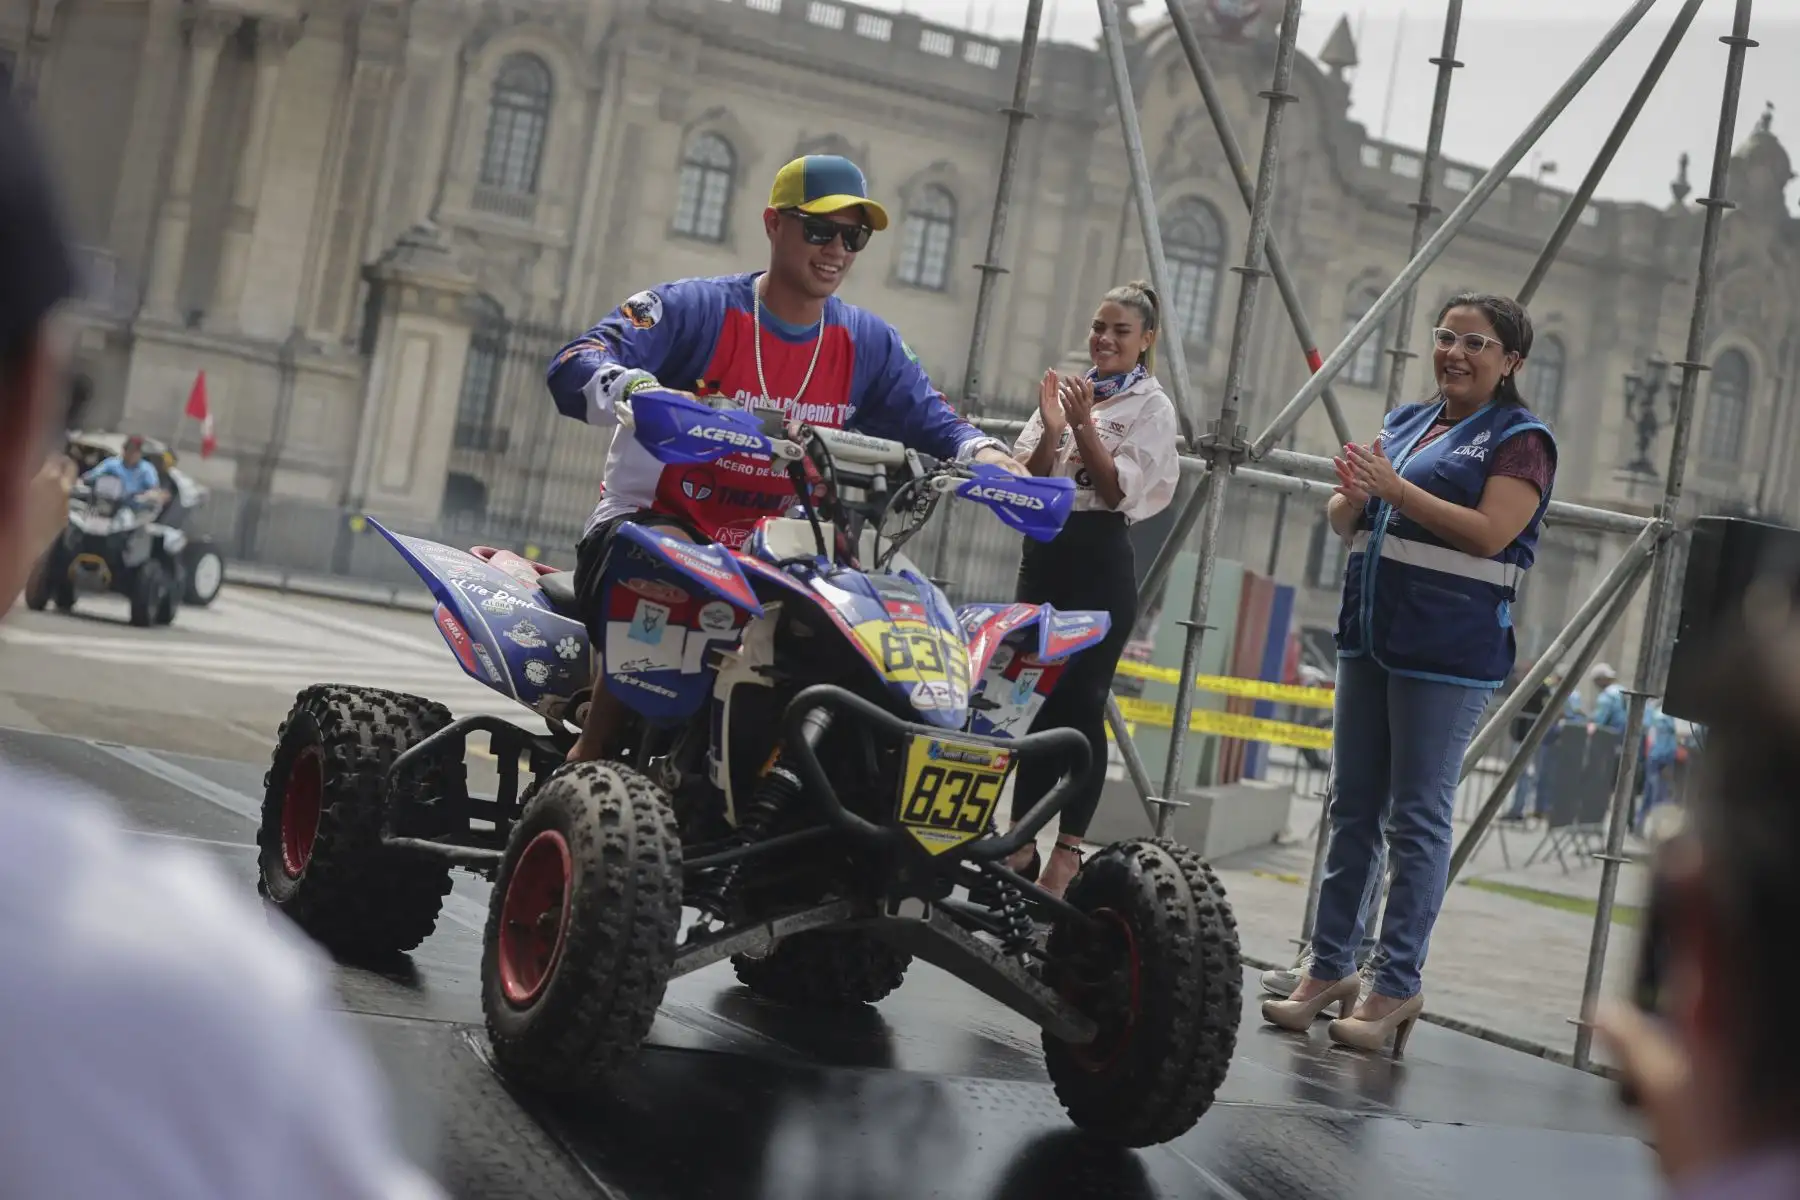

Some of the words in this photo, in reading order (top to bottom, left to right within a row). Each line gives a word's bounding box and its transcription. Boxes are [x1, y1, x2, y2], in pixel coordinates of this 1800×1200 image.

[783, 399, 835, 424] Phoenix
[686, 425, 763, 449] ACERBIS
[1452, 445, 1487, 462] LIMA
[715, 457, 754, 475] ACERO
[756, 467, 769, 477] DE
[966, 484, 1045, 511] ACERBIS
[457, 579, 488, 596] Life
[903, 764, 999, 834] 835
